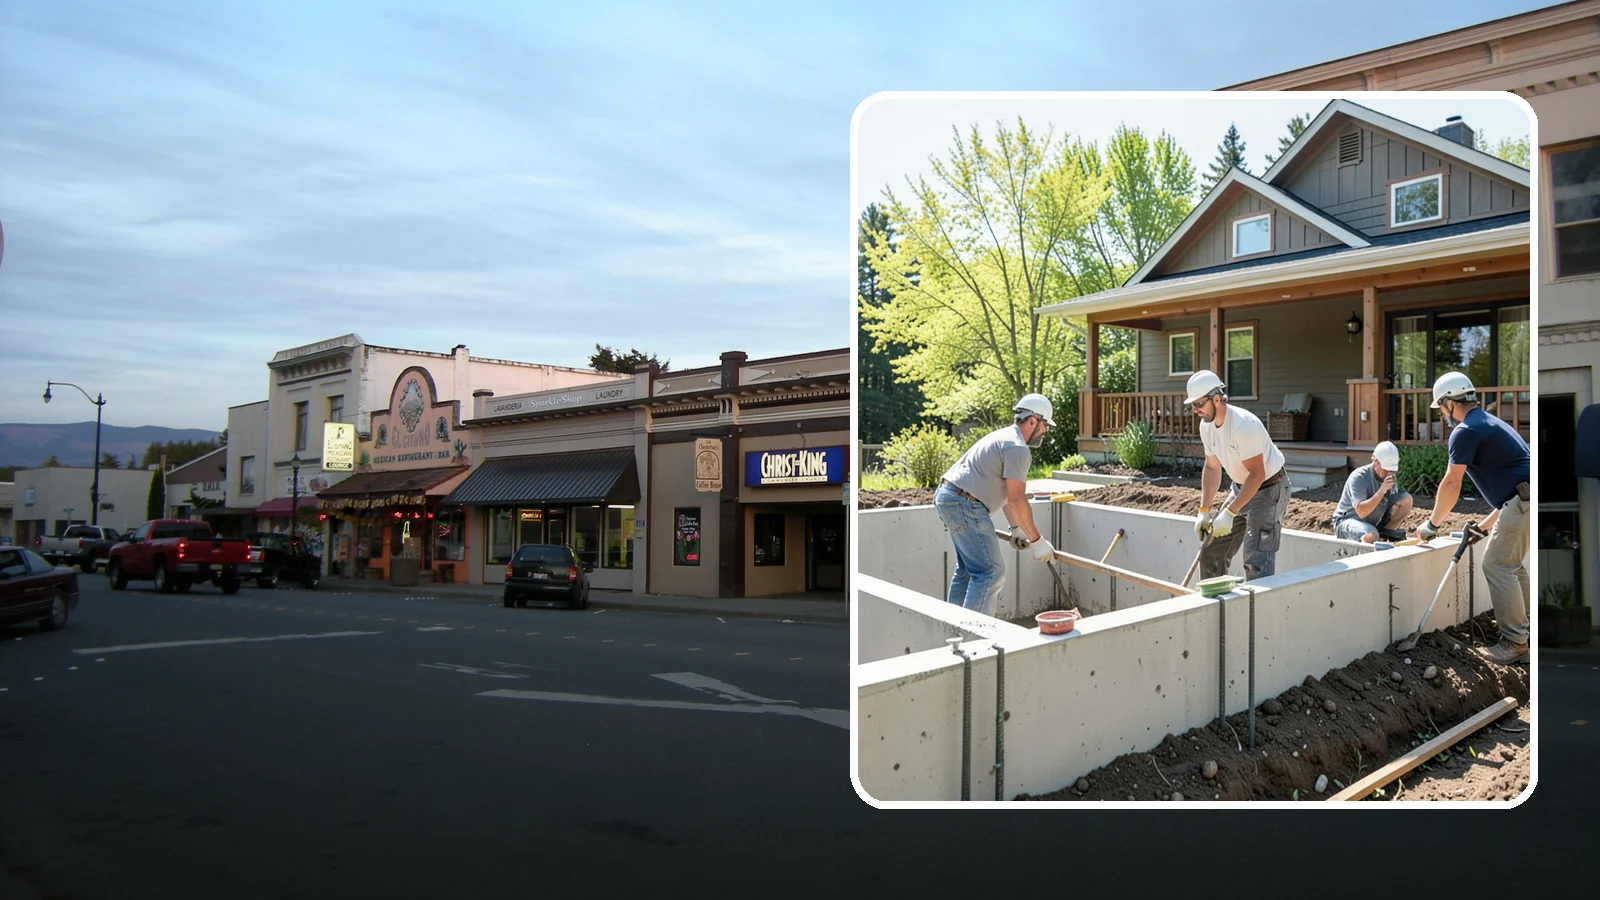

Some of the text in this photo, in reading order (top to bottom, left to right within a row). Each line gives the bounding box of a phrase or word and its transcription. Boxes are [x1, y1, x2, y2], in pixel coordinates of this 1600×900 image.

[530, 394, 582, 409] Sparkle Shop
[595, 389, 623, 400] LAUNDRY
[493, 402, 522, 412] LAVANDERIA
[392, 426, 401, 449] EL
[373, 455, 396, 464] MEXICAN
[397, 451, 433, 462] RESTAURANT
[438, 450, 450, 458] BAR
[761, 450, 827, 478] CHRIST KING
[696, 480, 722, 489] Coffee House
